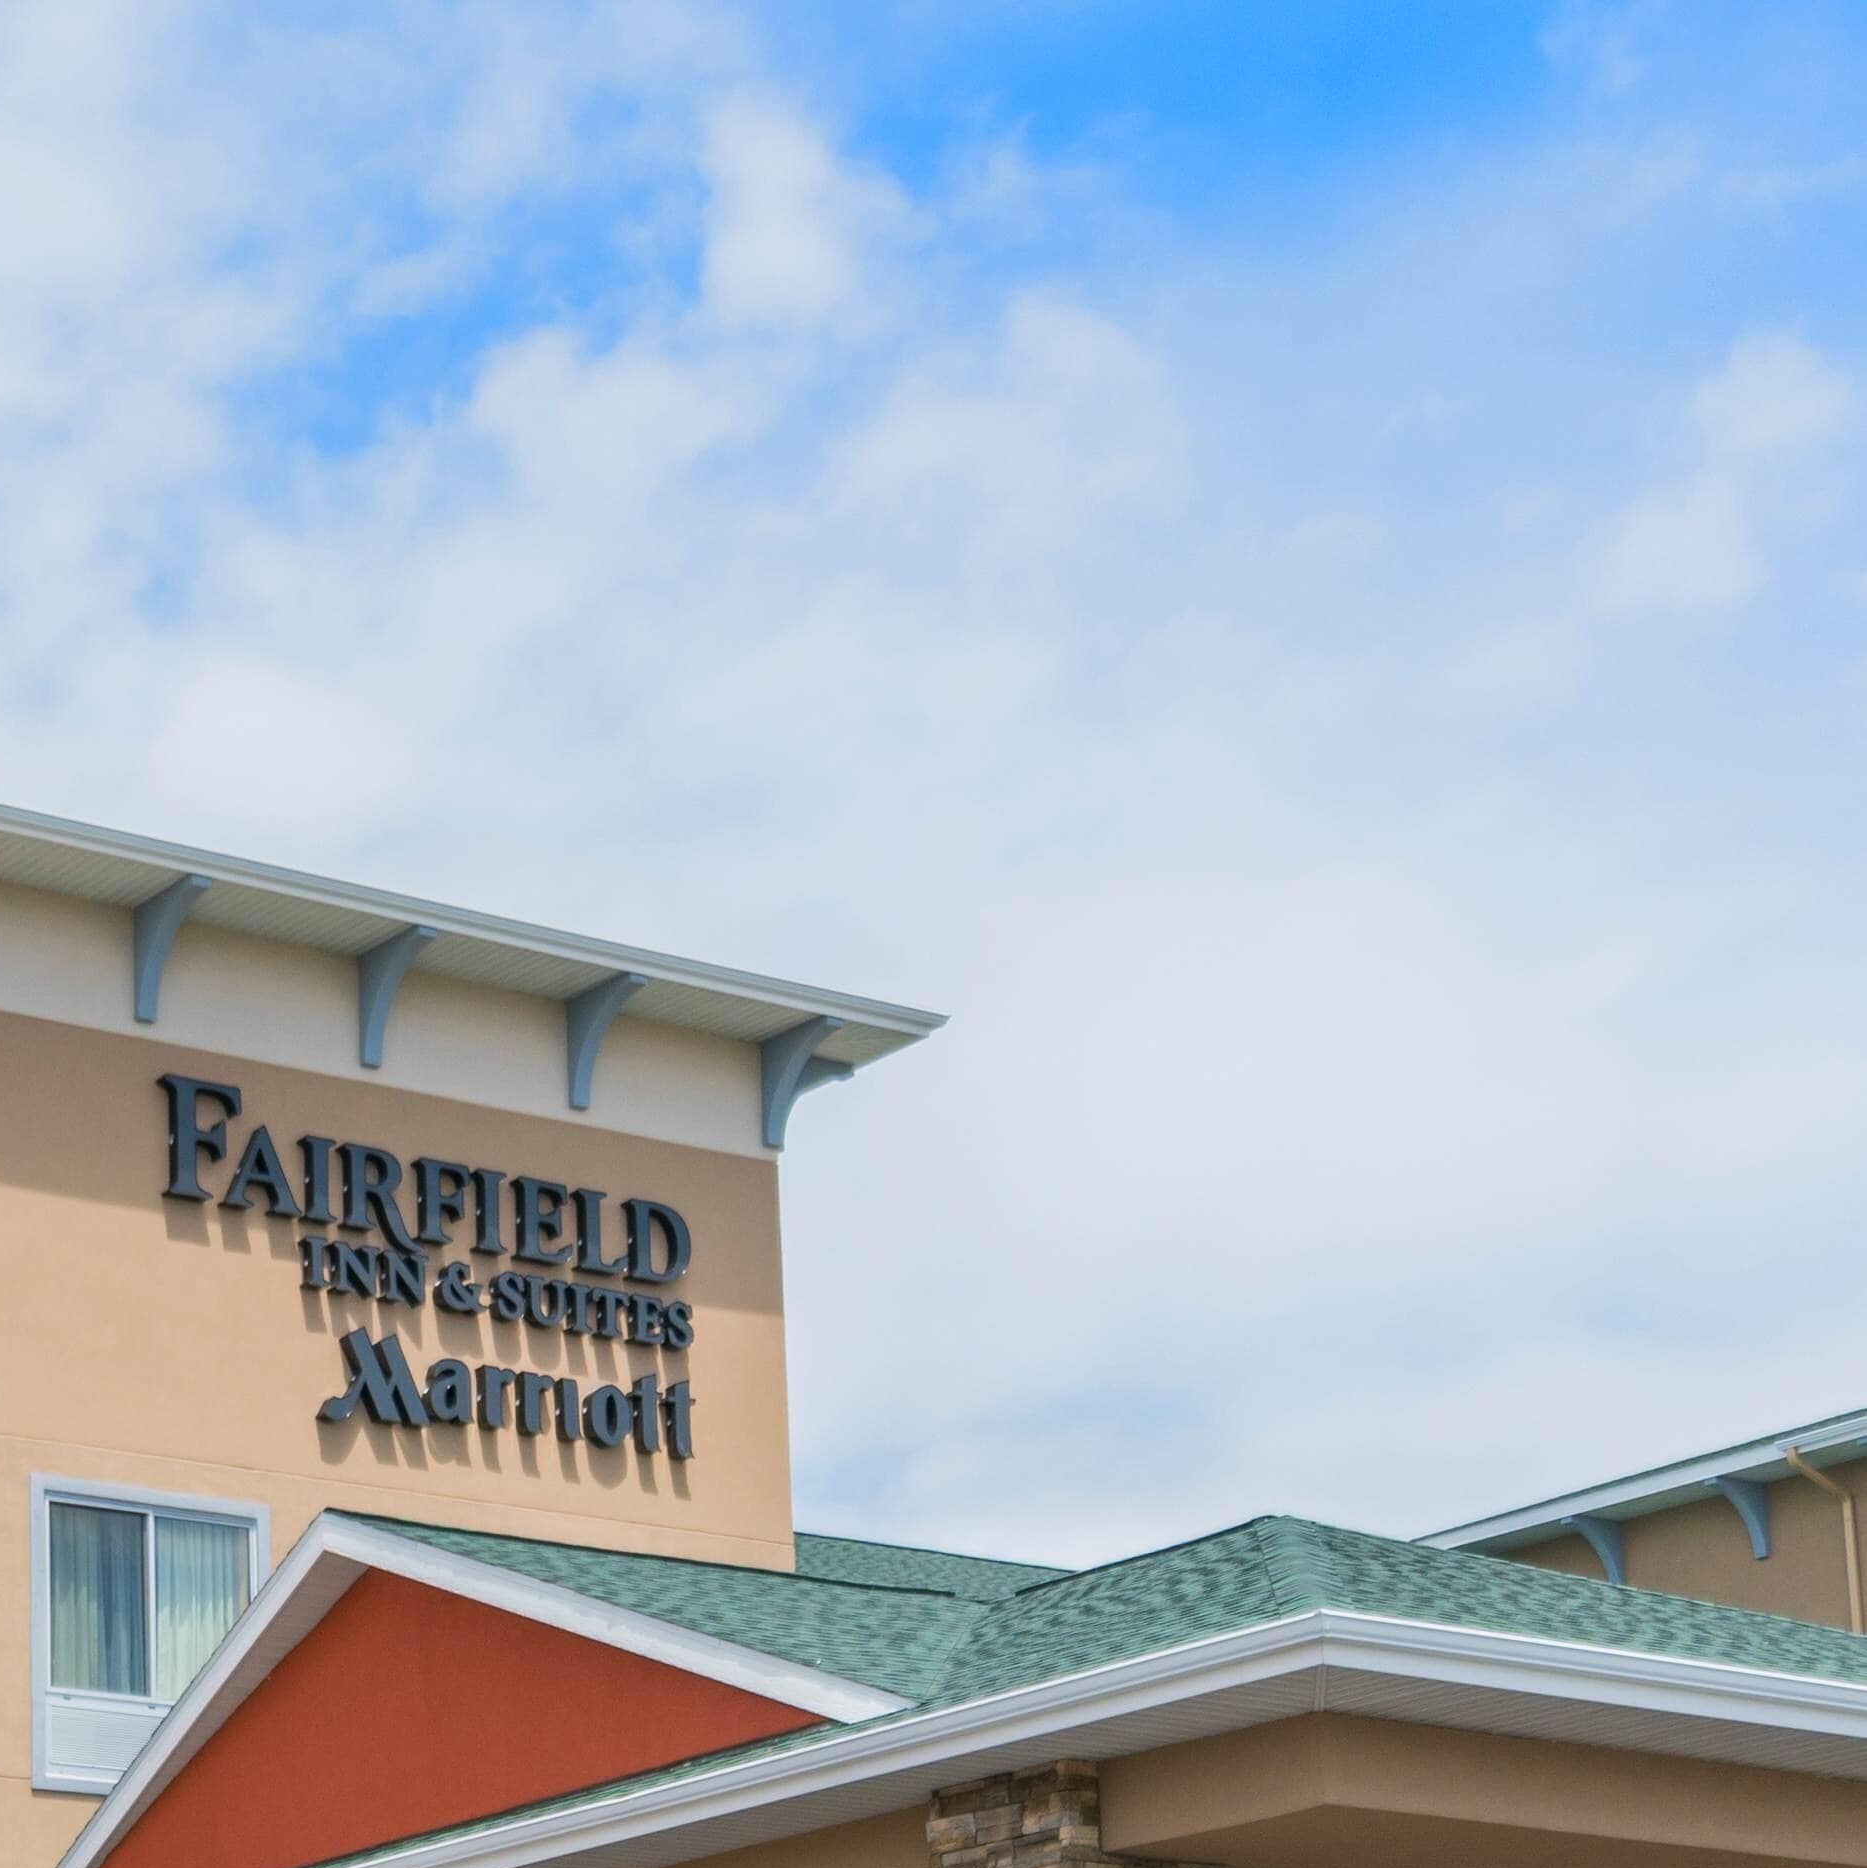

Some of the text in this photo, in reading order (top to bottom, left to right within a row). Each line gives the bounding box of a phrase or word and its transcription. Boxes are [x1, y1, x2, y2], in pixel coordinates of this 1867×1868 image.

[157, 1073, 692, 1285] FAIRFIELD
[298, 1235, 694, 1351] INN & SUITES
[316, 1327, 696, 1459] Marriott
